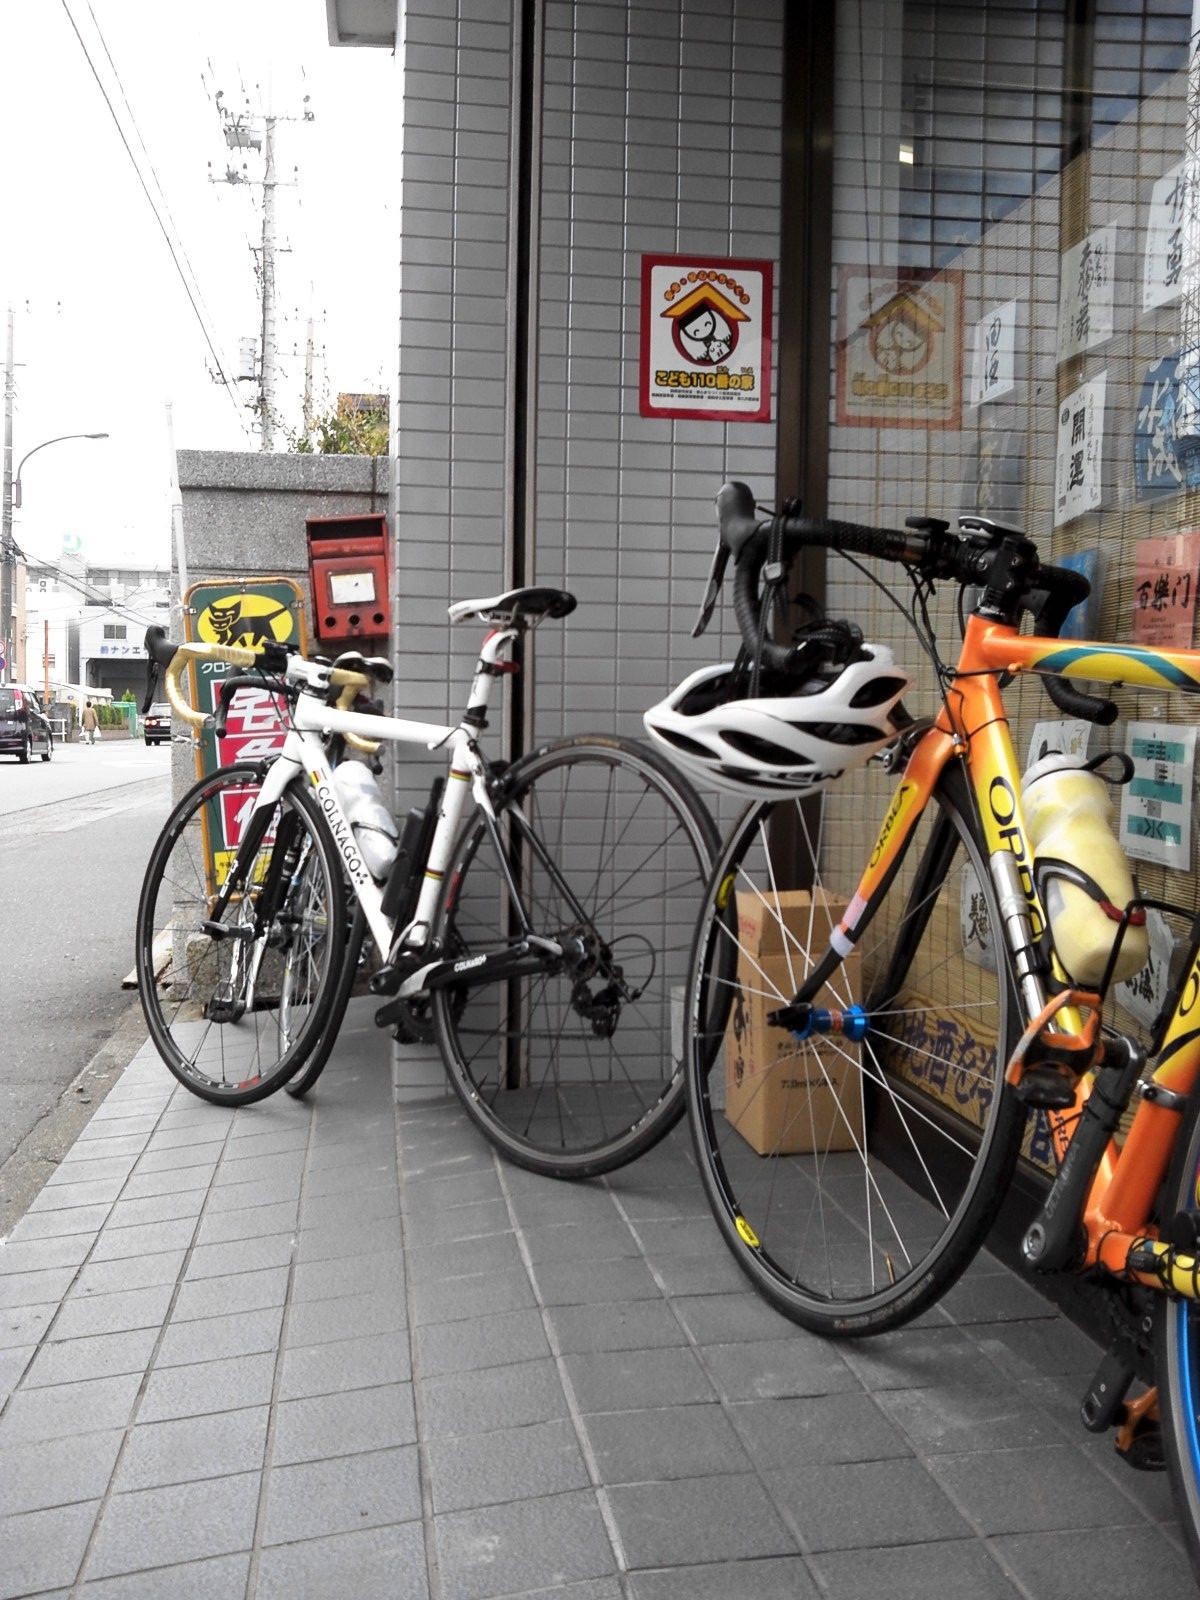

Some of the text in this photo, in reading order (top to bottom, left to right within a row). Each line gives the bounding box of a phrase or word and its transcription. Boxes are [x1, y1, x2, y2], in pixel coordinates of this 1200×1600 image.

[655, 370, 755, 391] こども110番の家
[1069, 406, 1086, 492] 開運
[318, 786, 361, 873] COLNAGO
